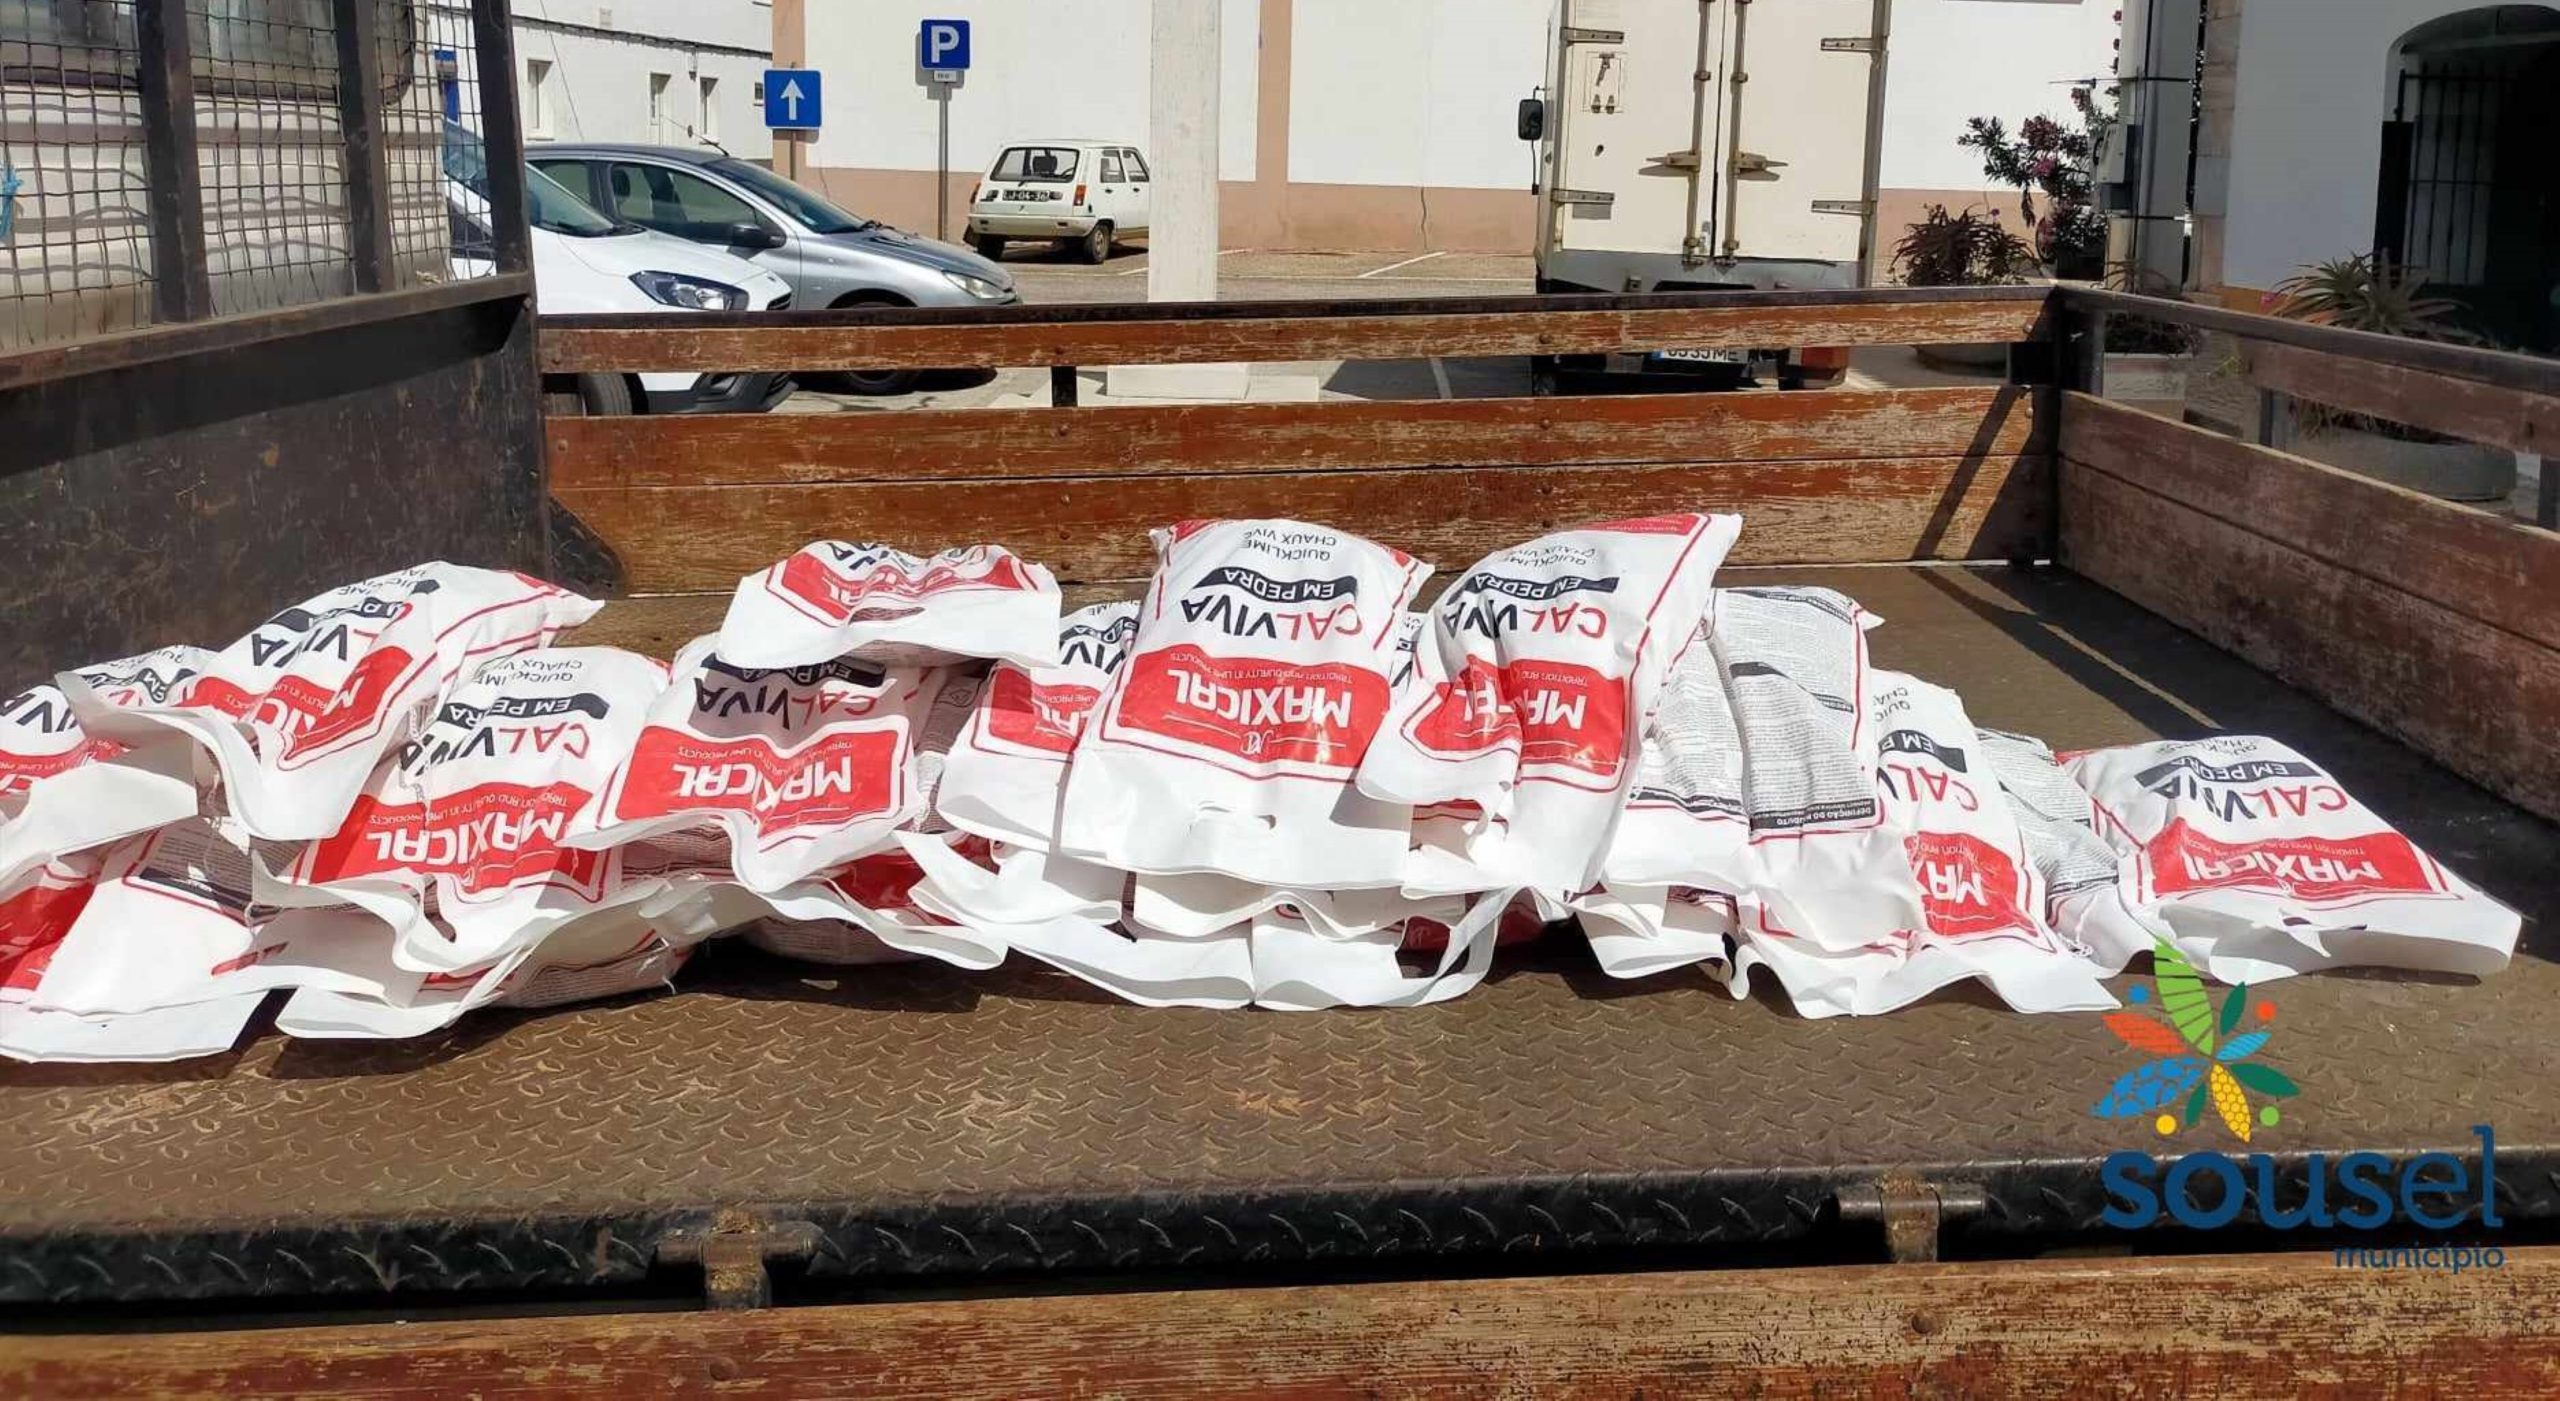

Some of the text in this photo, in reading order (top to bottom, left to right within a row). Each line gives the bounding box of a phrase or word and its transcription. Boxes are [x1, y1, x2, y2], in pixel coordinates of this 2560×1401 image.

[931, 25, 960, 63] P
[1239, 539, 1330, 561] QUICKLIME
[1281, 532, 1336, 547] CHAUX
[1223, 569, 1335, 600] EM PEDRA
[1473, 574, 1548, 598] PEDRA
[1167, 669, 1352, 728] MAXICAL
[449, 699, 572, 727] EM PERA
[1901, 732, 1934, 751] EM
[2252, 763, 2289, 776] EM
[672, 756, 852, 812] MAXICAL
[365, 809, 565, 865] MAXICAL
